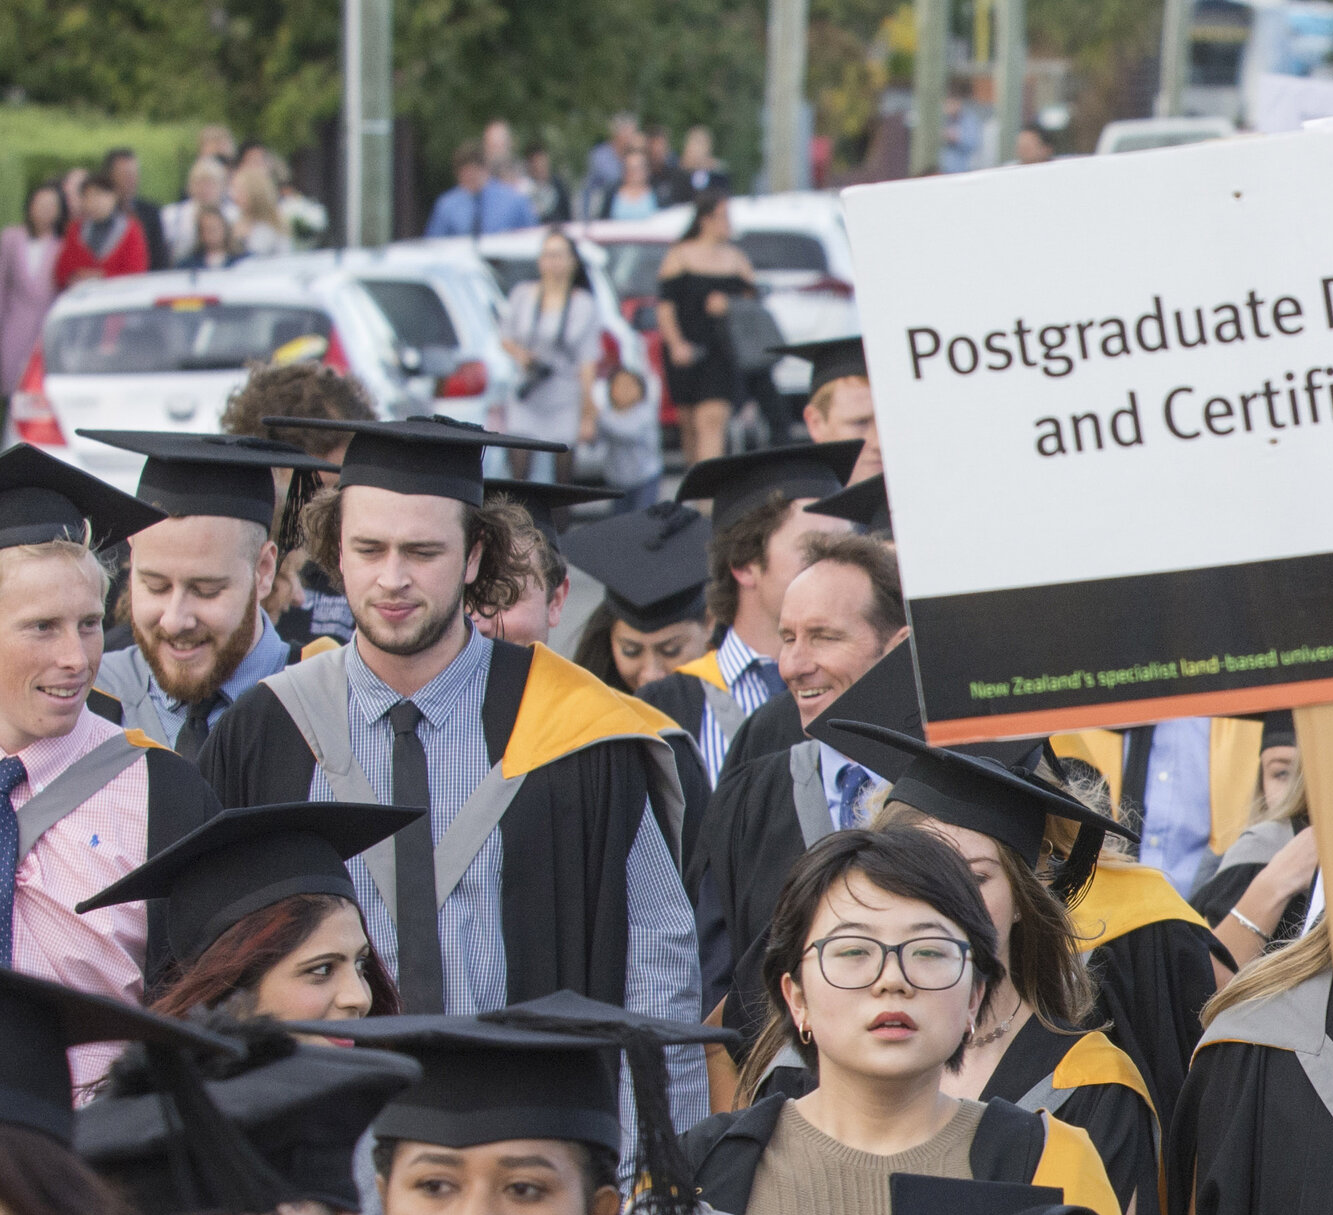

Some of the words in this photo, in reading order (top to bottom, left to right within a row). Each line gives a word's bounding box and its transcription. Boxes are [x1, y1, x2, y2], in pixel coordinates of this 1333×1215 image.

[908, 291, 1303, 379] Postgraduate
[1036, 392, 1143, 456] and
[970, 683, 1009, 698] New
[1013, 671, 1094, 695] Zealand's
[1098, 663, 1178, 688] specialist
[1180, 650, 1278, 676] land-based
